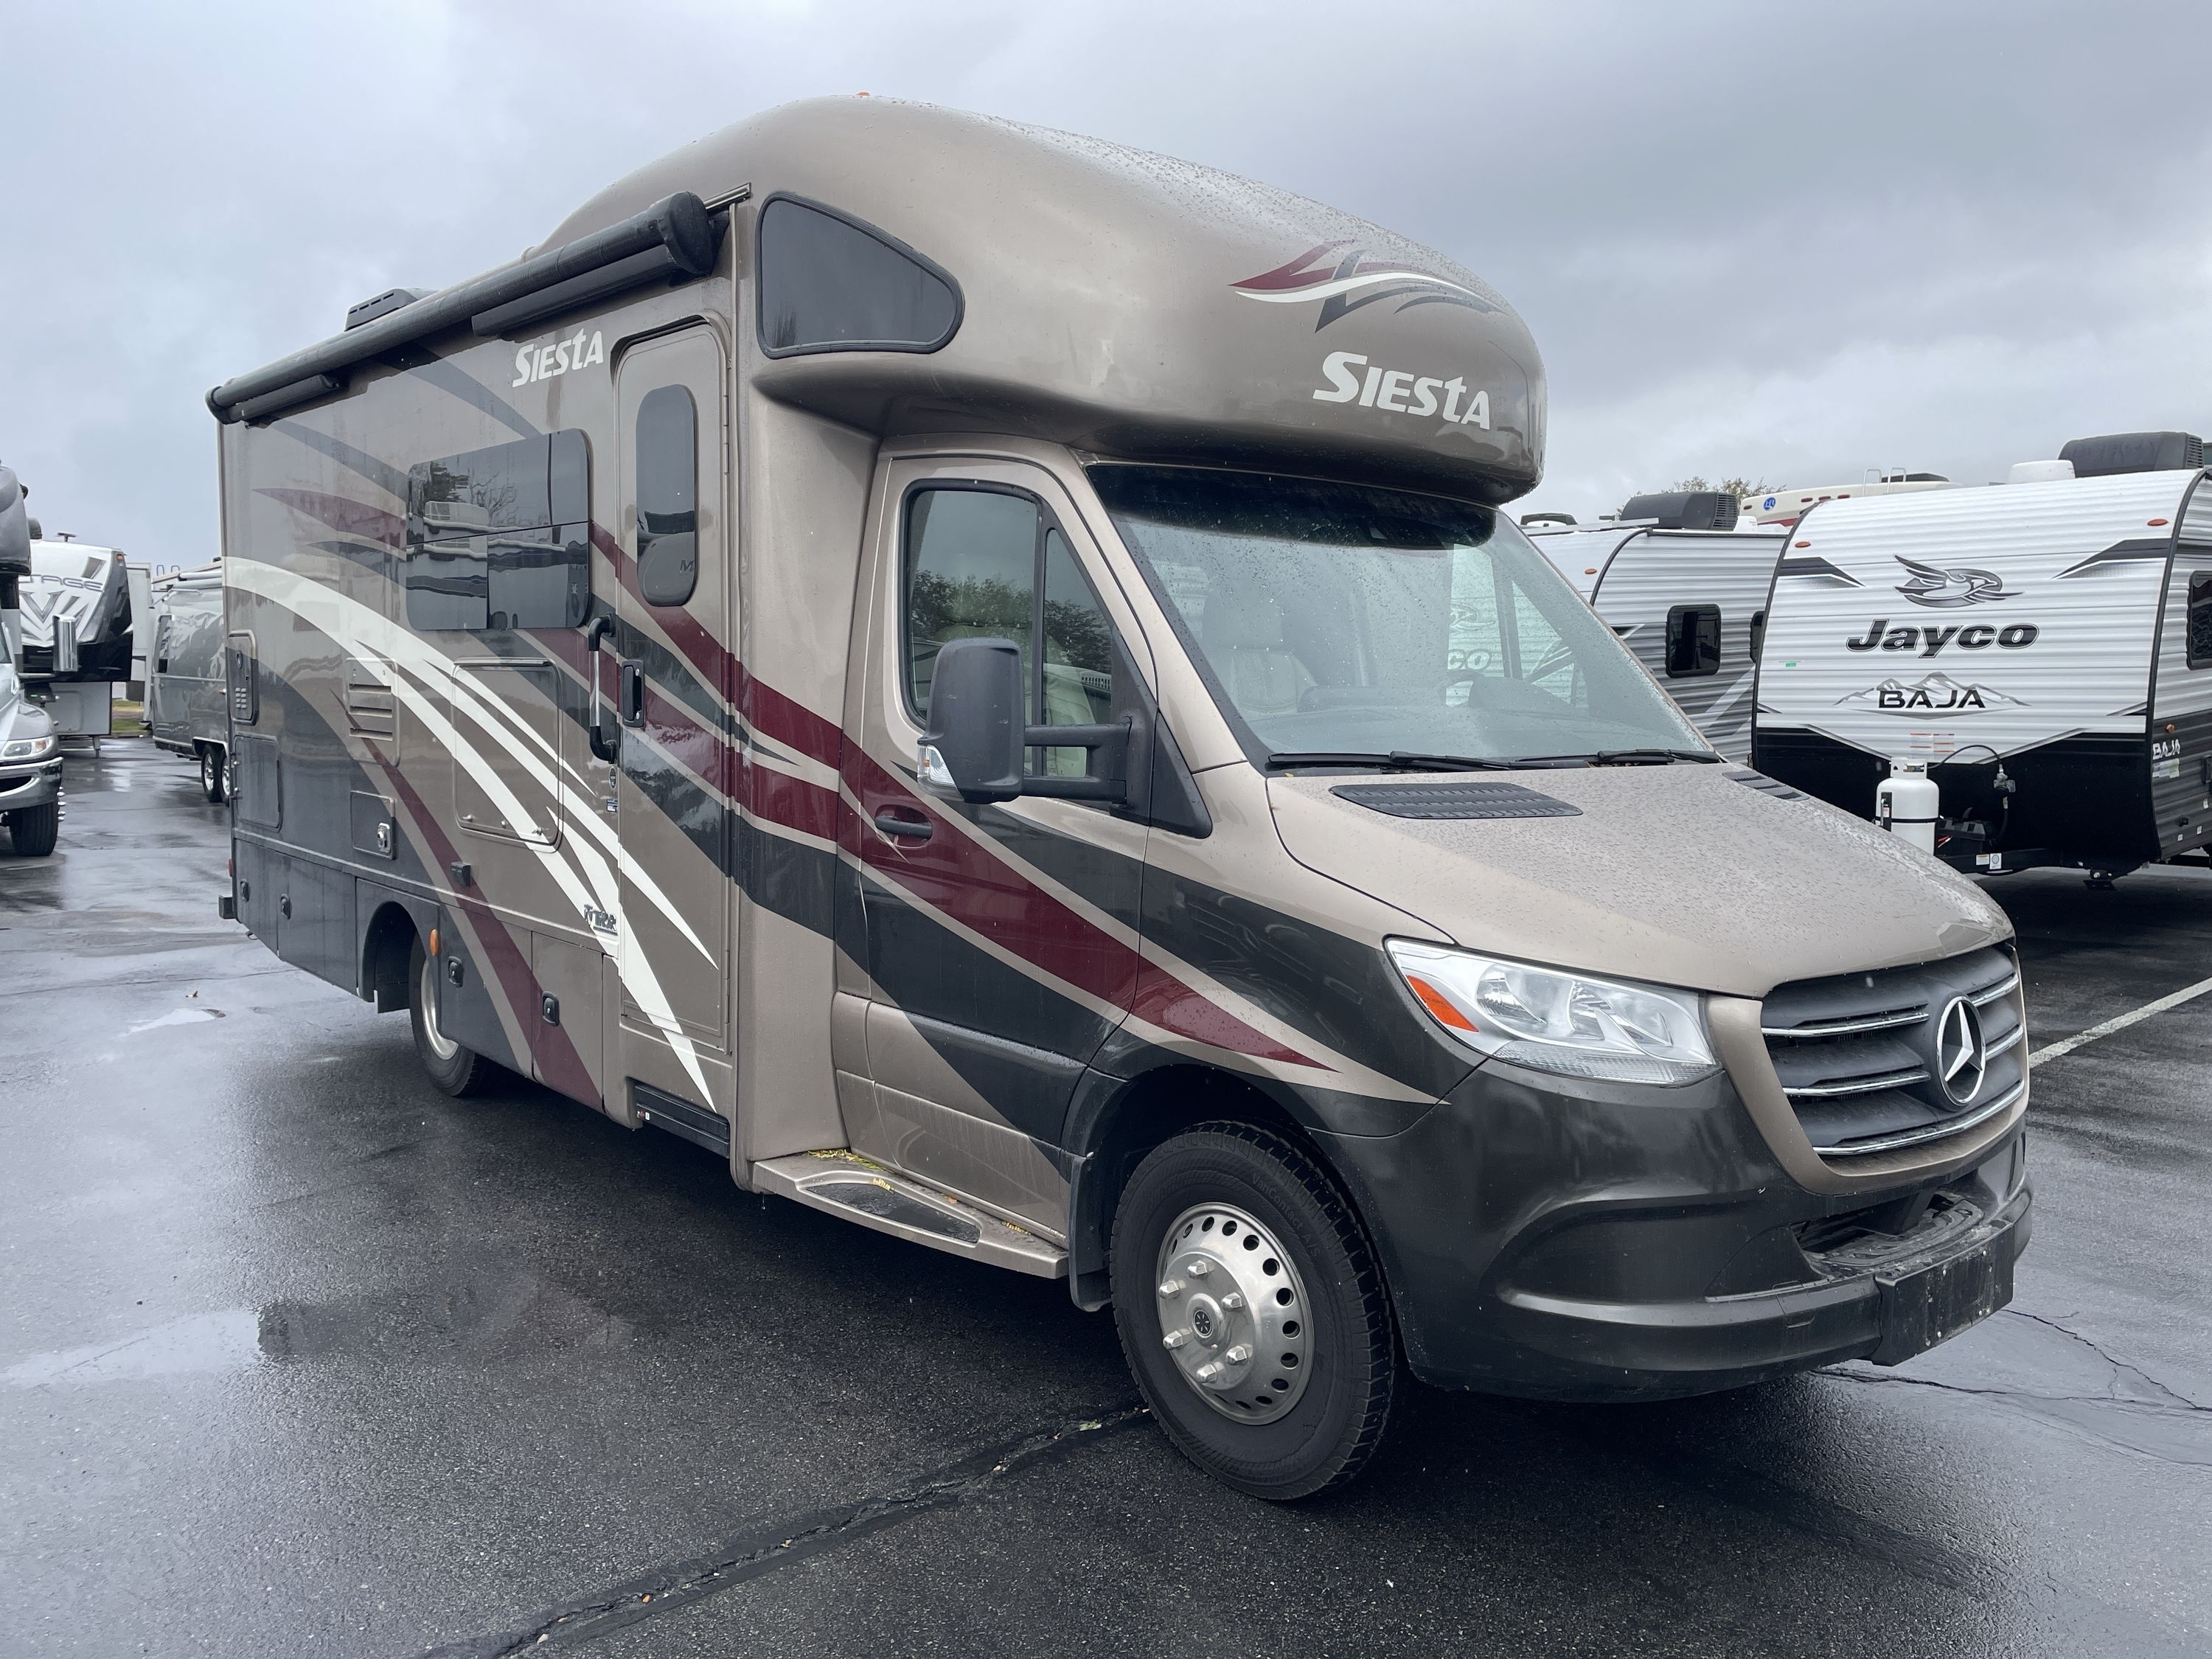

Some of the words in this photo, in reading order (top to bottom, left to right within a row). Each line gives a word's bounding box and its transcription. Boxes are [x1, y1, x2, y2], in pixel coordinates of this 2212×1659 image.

[512, 328, 603, 387] SIESTA
[1312, 351, 1490, 430] SIESTA
[1846, 618, 2040, 658] Jayco
[1878, 689, 1986, 709] BAJA
[2152, 738, 2180, 760] BAJA
